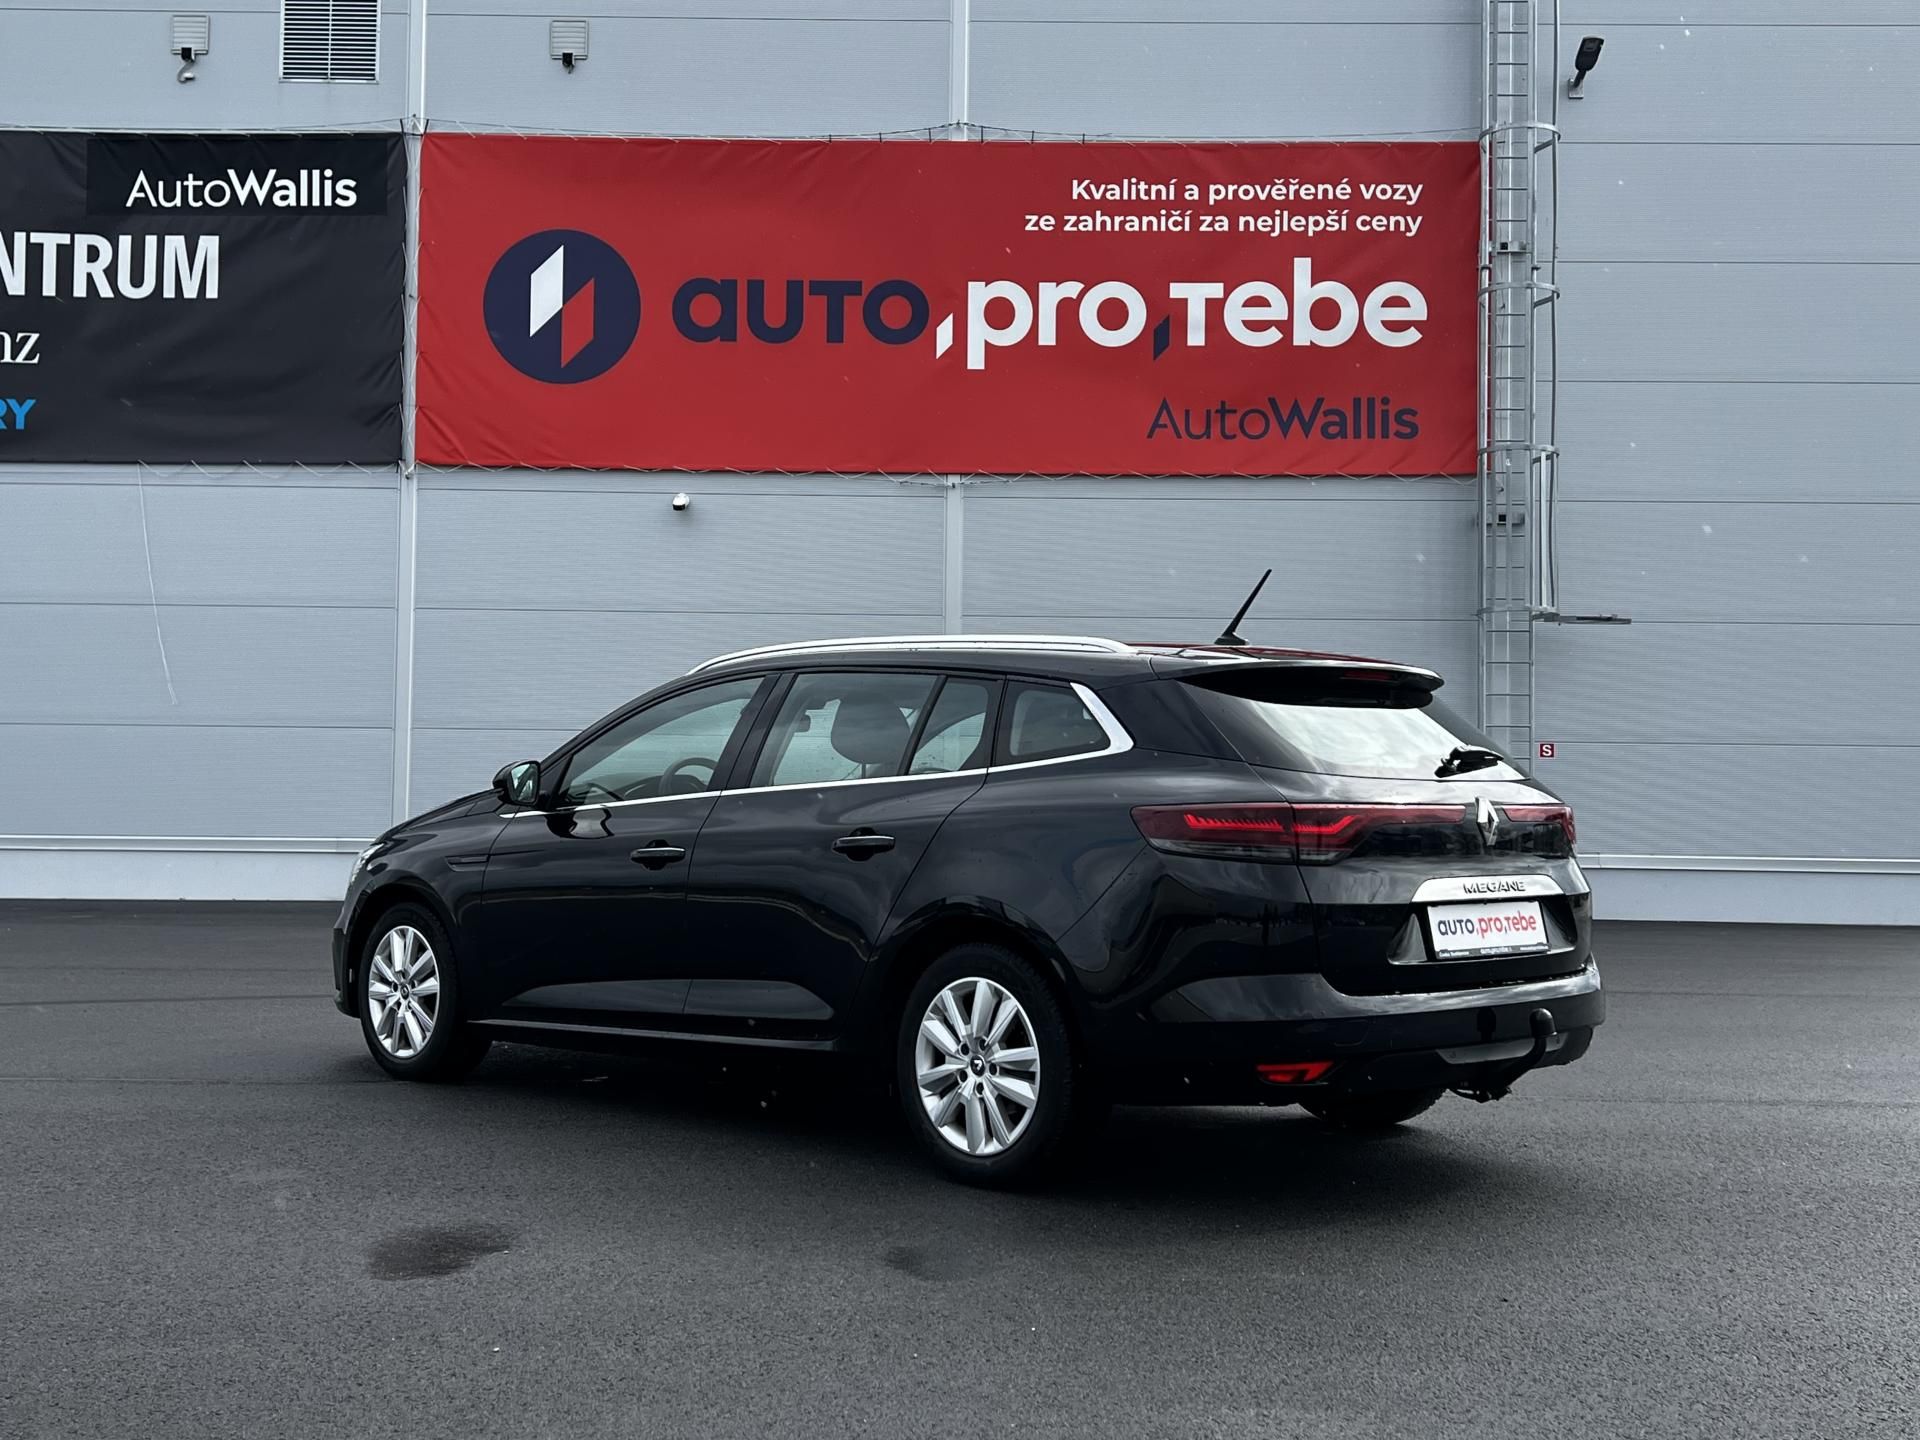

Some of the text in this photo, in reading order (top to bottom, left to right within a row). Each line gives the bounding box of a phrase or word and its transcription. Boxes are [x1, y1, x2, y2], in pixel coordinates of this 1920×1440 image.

[126, 168, 358, 208] AutoWallis
[1071, 178, 1424, 205] Kvalitní a prověřené vozy
[1024, 209, 1423, 237] ze zahraničí za nejlepší ceny
[1147, 397, 1419, 440] AutoWallis
[1542, 744, 1552, 756] S
